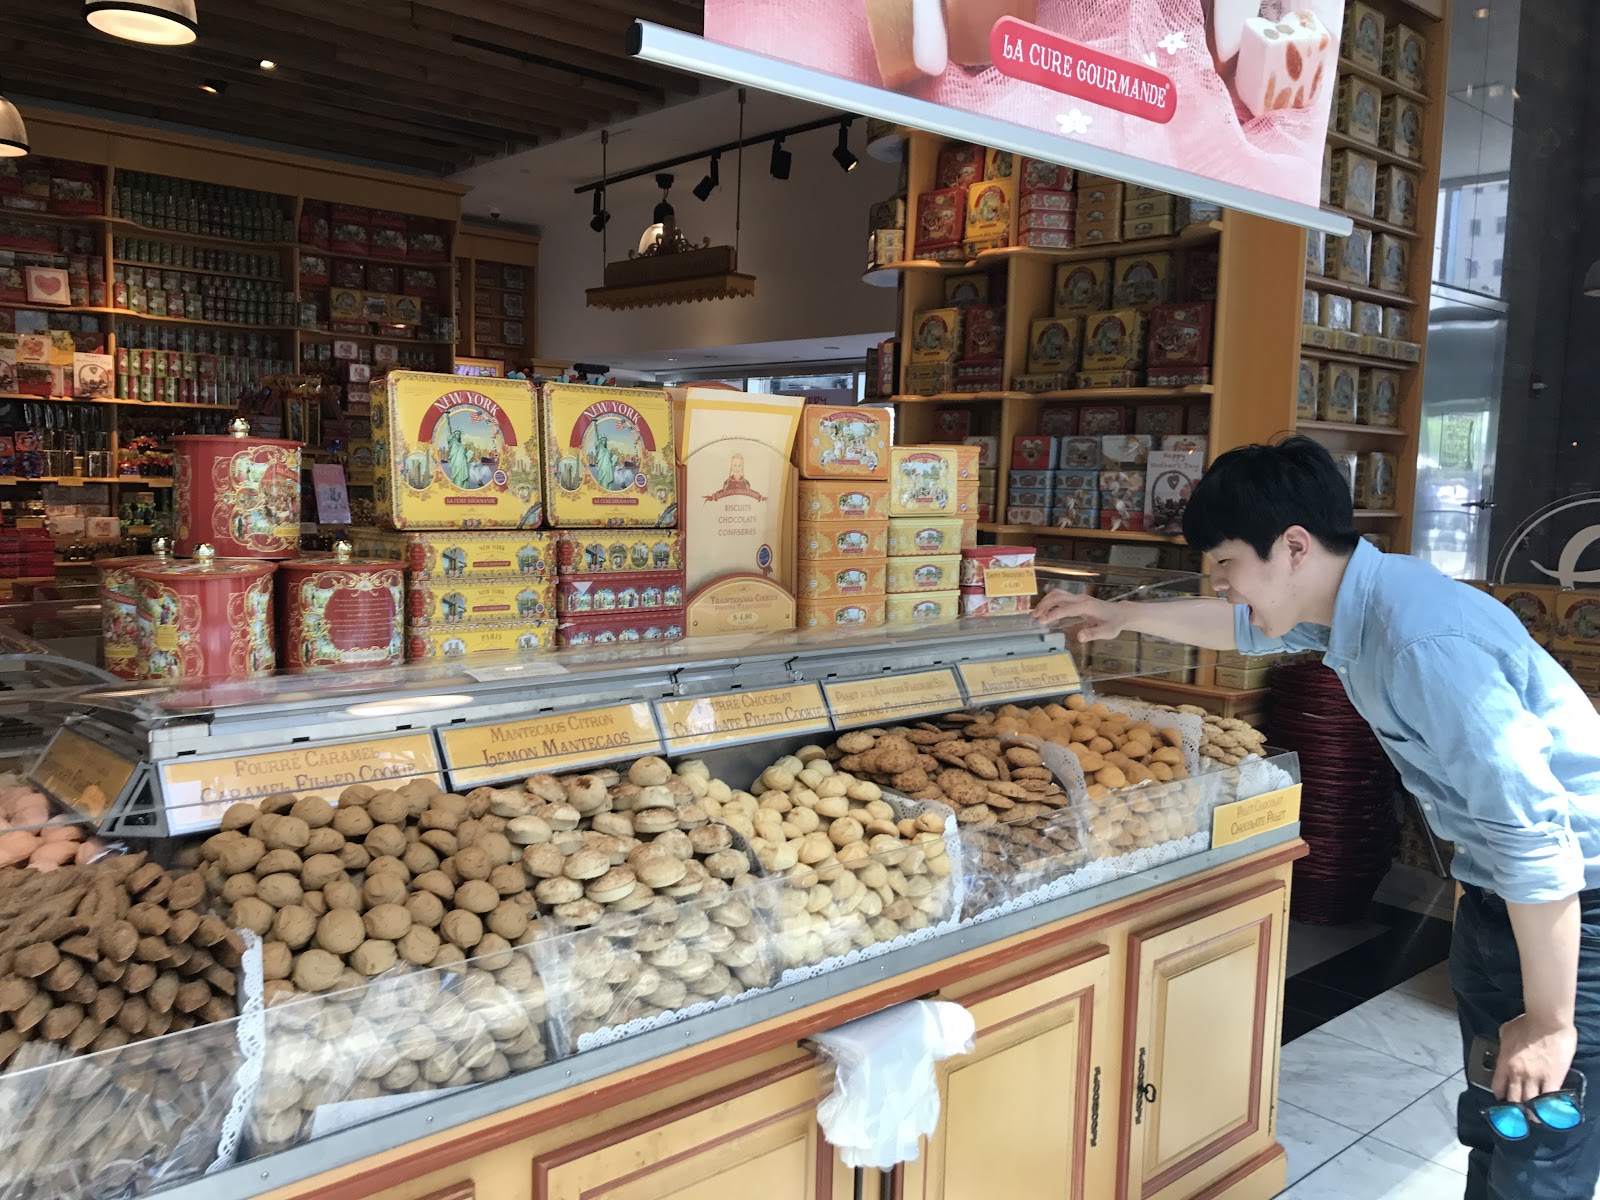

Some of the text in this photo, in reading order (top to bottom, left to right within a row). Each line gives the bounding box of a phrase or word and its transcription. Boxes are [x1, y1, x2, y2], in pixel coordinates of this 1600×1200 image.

[1002, 34, 1167, 109] LA CURE GOURMANDE
[434, 392, 500, 416] NEW YORK
[584, 402, 642, 424] NEW YORK
[724, 504, 751, 512] BISCUITS
[718, 516, 757, 524] CHOCOLATS
[718, 528, 756, 536] CONFISERIES
[481, 633, 502, 641] PARIS
[742, 692, 793, 708] CHOCOLAT
[743, 711, 784, 727] FILLED
[490, 713, 615, 744] MANTECAOS CITRON
[481, 731, 632, 768] LEMON MANTECAOS
[234, 746, 379, 777] FOURRÉ CARAMEL
[294, 772, 356, 790] FILLED
